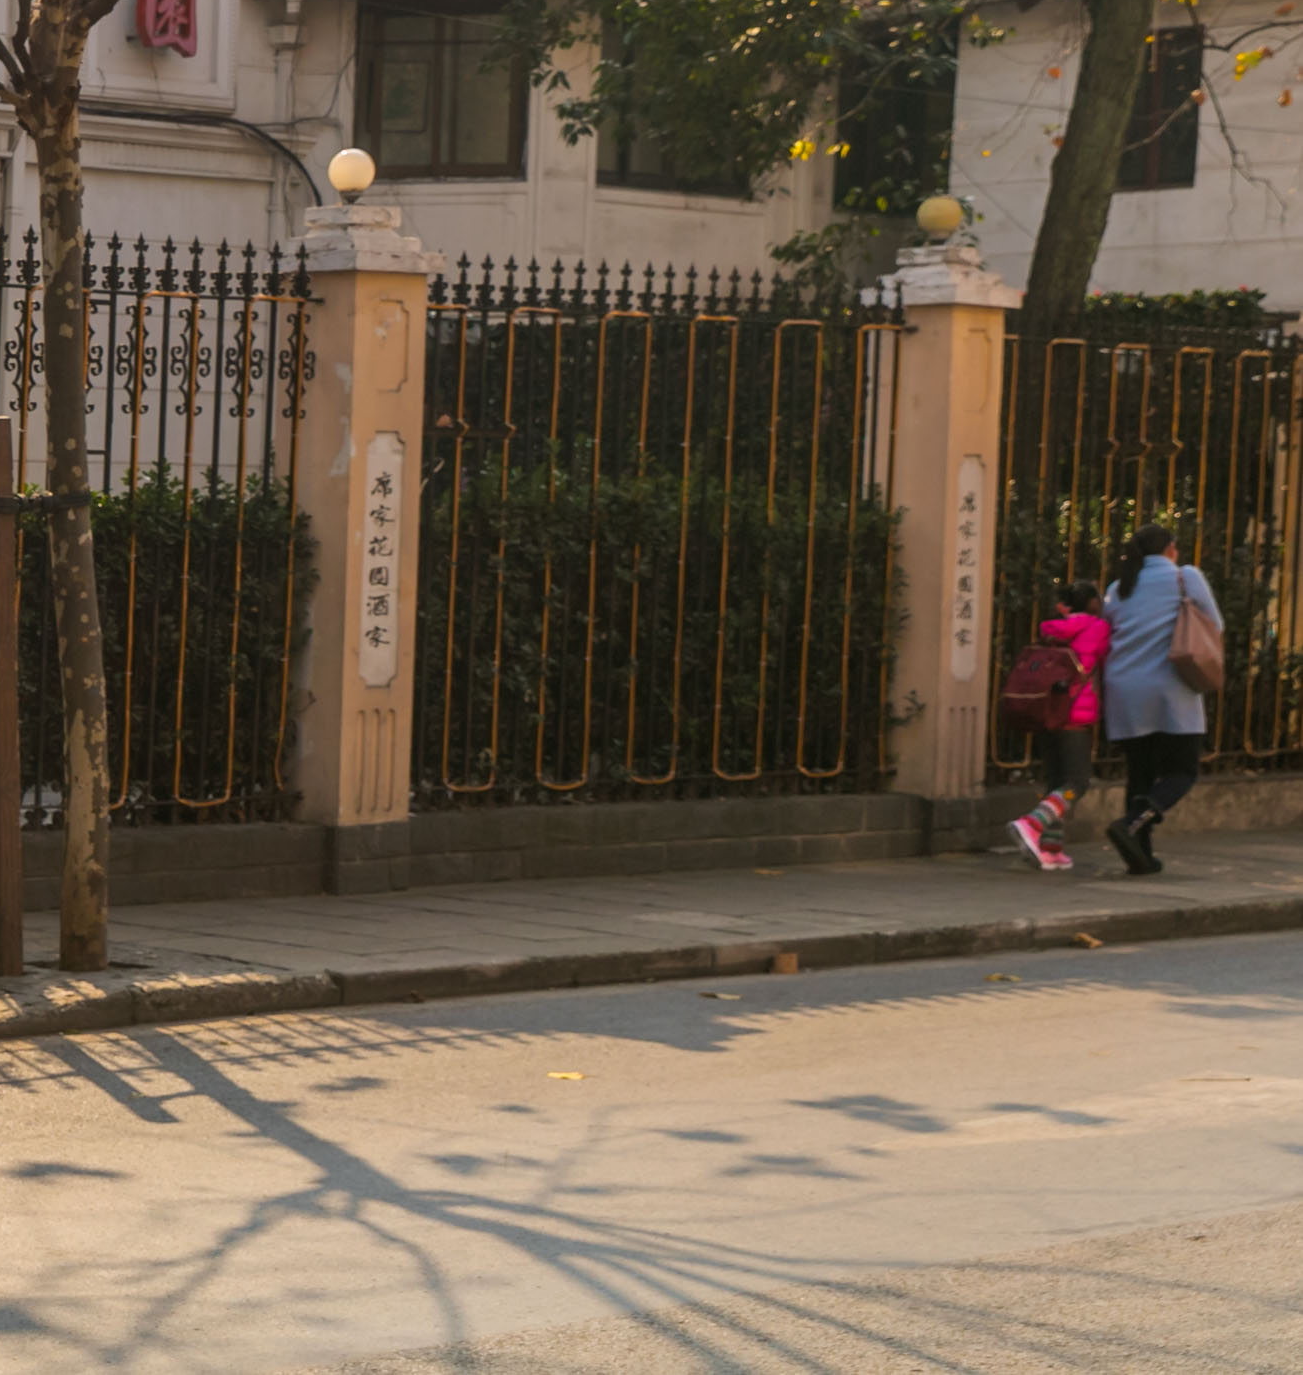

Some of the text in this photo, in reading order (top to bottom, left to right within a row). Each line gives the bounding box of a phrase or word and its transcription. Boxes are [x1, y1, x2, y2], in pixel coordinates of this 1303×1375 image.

[363, 470, 396, 648] 席家花園酒家
